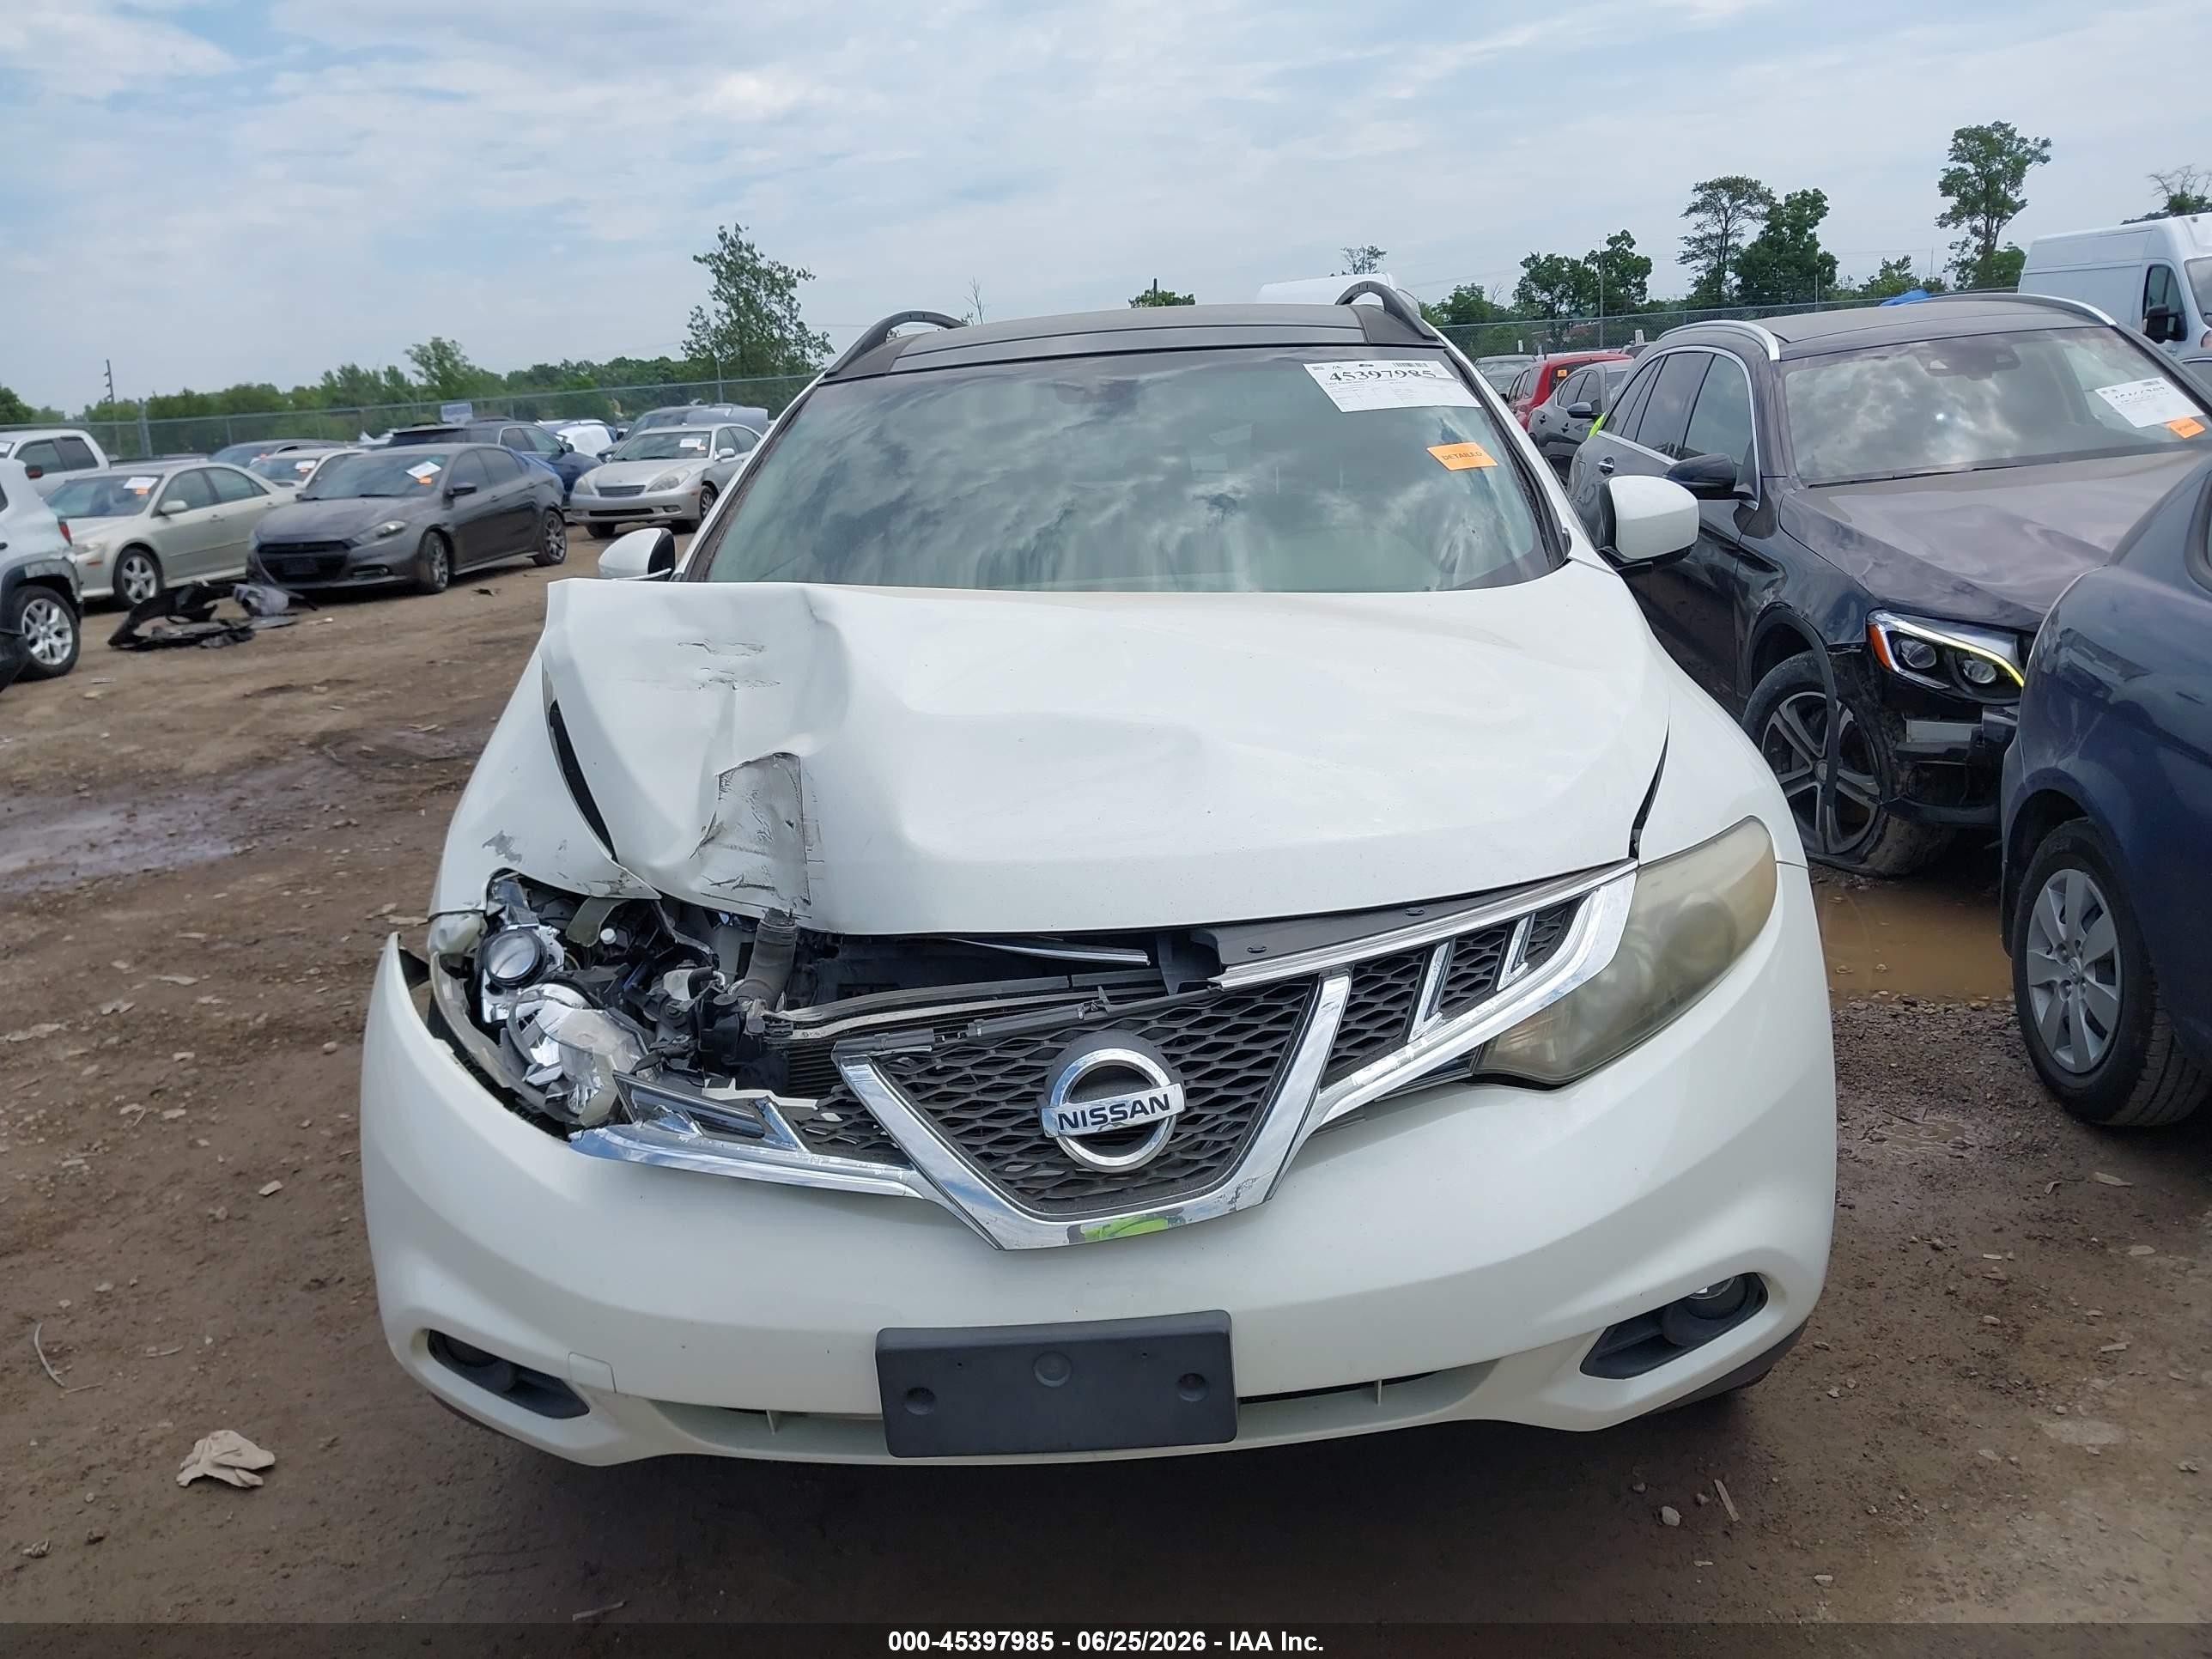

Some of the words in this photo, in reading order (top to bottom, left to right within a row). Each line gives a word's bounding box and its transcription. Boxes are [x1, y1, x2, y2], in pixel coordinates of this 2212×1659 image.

[1329, 369, 1437, 381] 45397985
[1441, 451, 1483, 461] DETAILED
[1057, 1093, 1170, 1131] NISSAN
